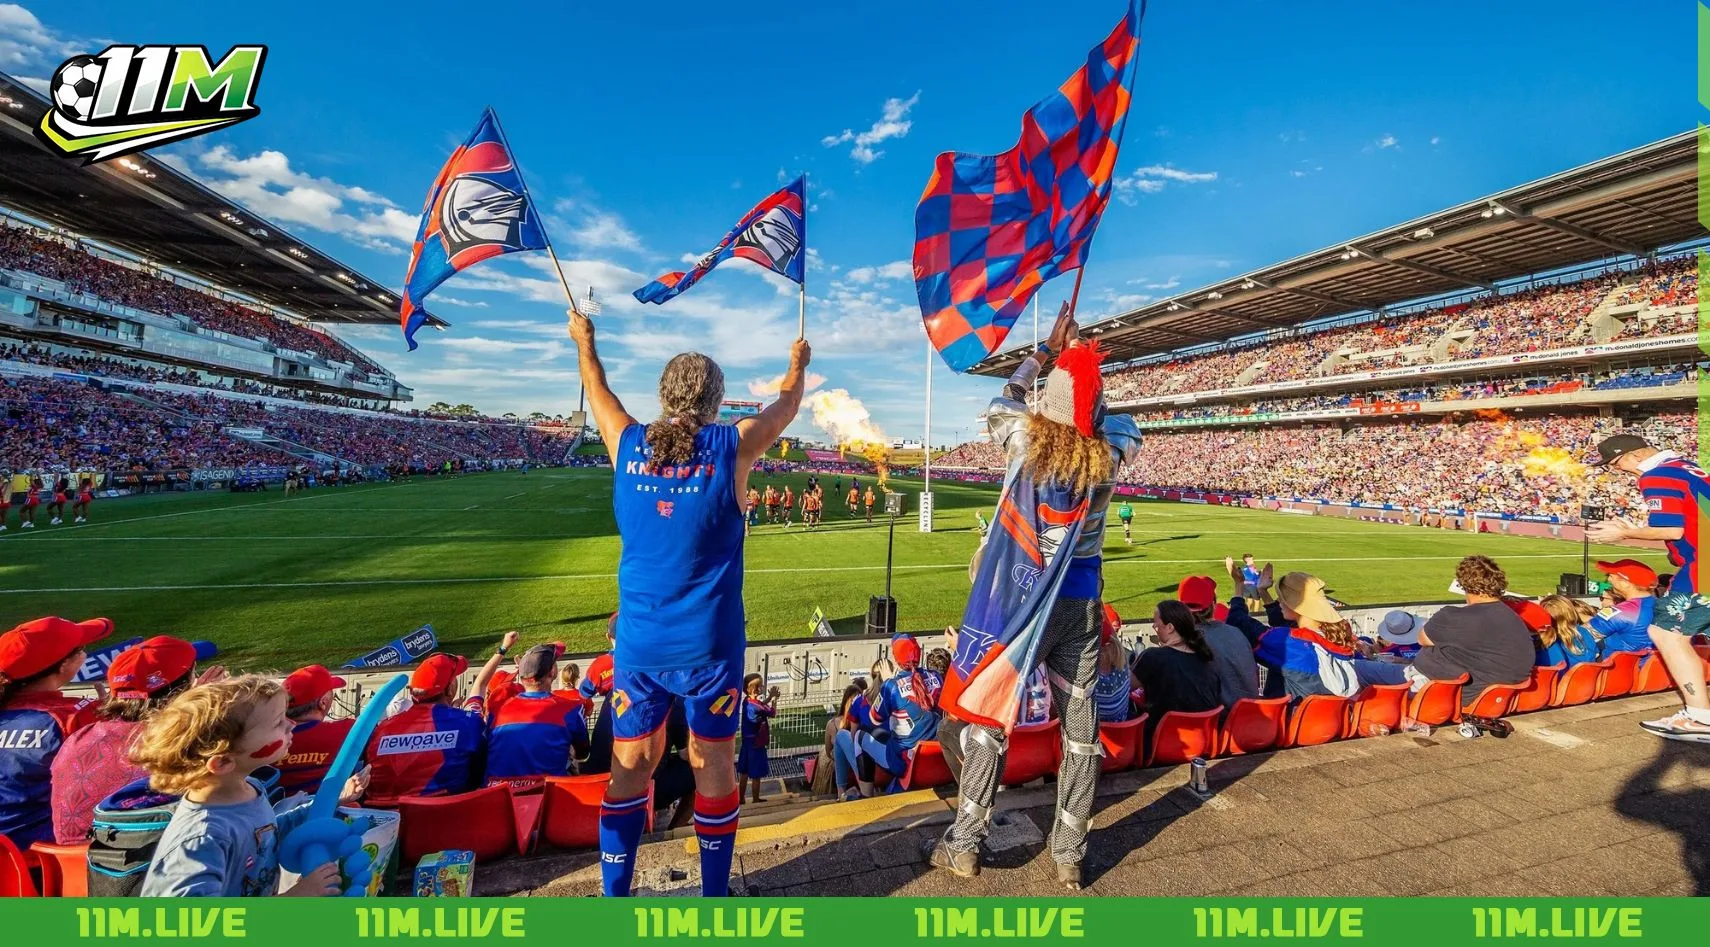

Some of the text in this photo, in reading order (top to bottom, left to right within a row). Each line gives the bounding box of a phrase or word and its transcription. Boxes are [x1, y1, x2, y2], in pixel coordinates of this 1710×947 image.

[626, 461, 716, 479] KNIGHTS
[637, 484, 661, 493] EST.
[404, 632, 430, 649] brydens
[367, 650, 397, 667] brydens
[0, 729, 48, 748] ALEX
[380, 732, 455, 749] newpave
[277, 751, 329, 765] Penny
